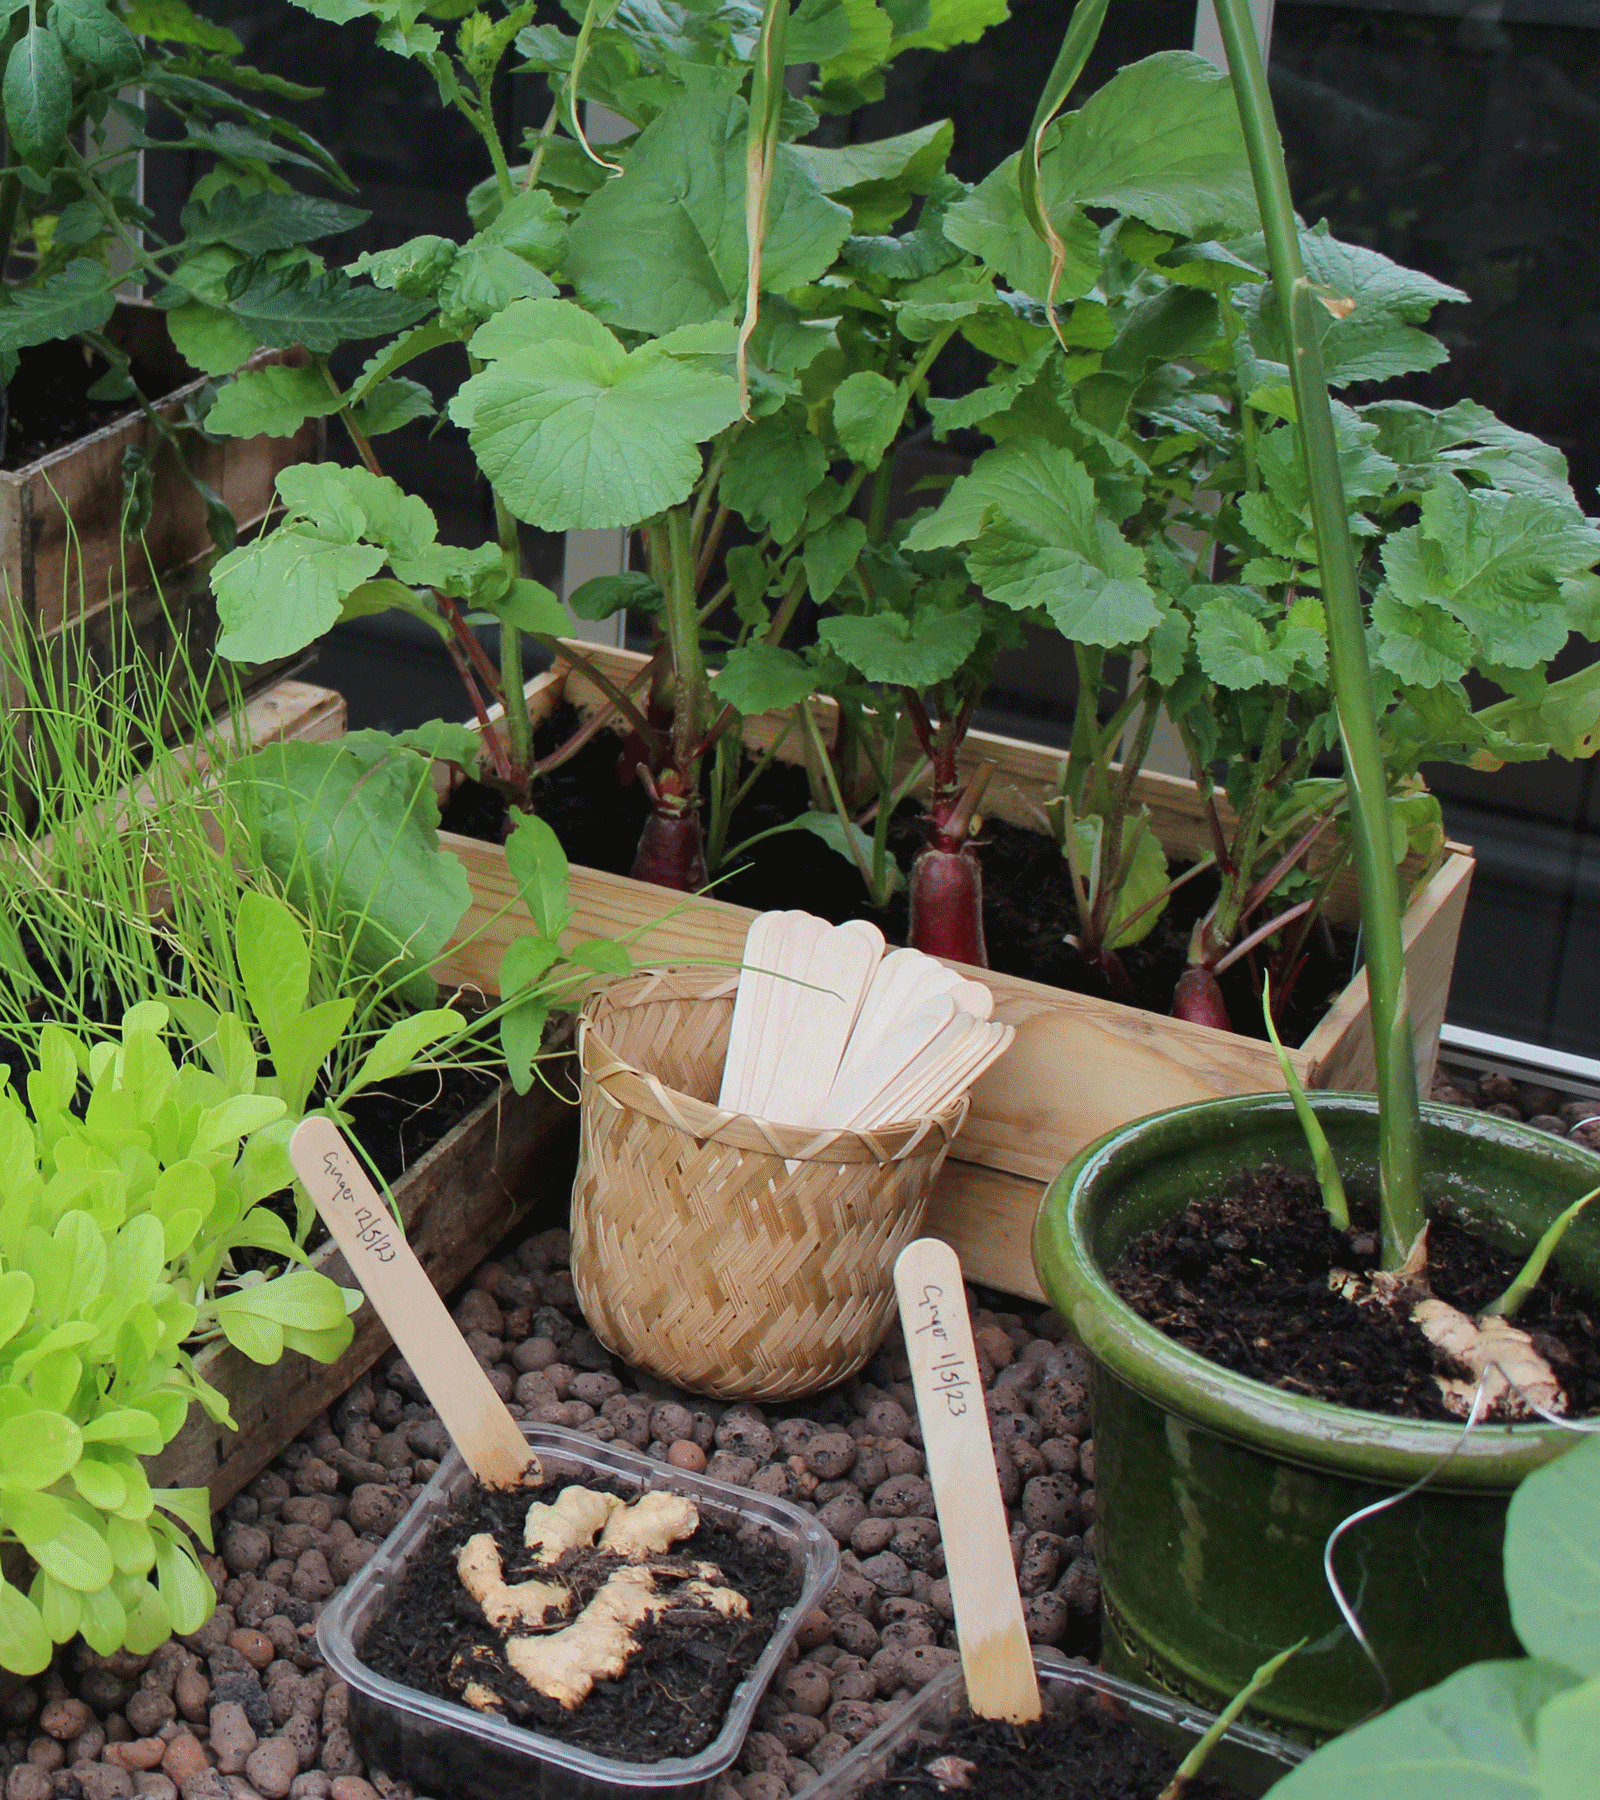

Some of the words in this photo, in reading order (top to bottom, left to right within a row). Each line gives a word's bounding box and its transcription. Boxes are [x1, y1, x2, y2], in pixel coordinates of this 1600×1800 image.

[323, 1151, 355, 1202] Ginger
[355, 1206, 397, 1263] 12/5/23
[931, 1352, 971, 1417] 1/5/23
